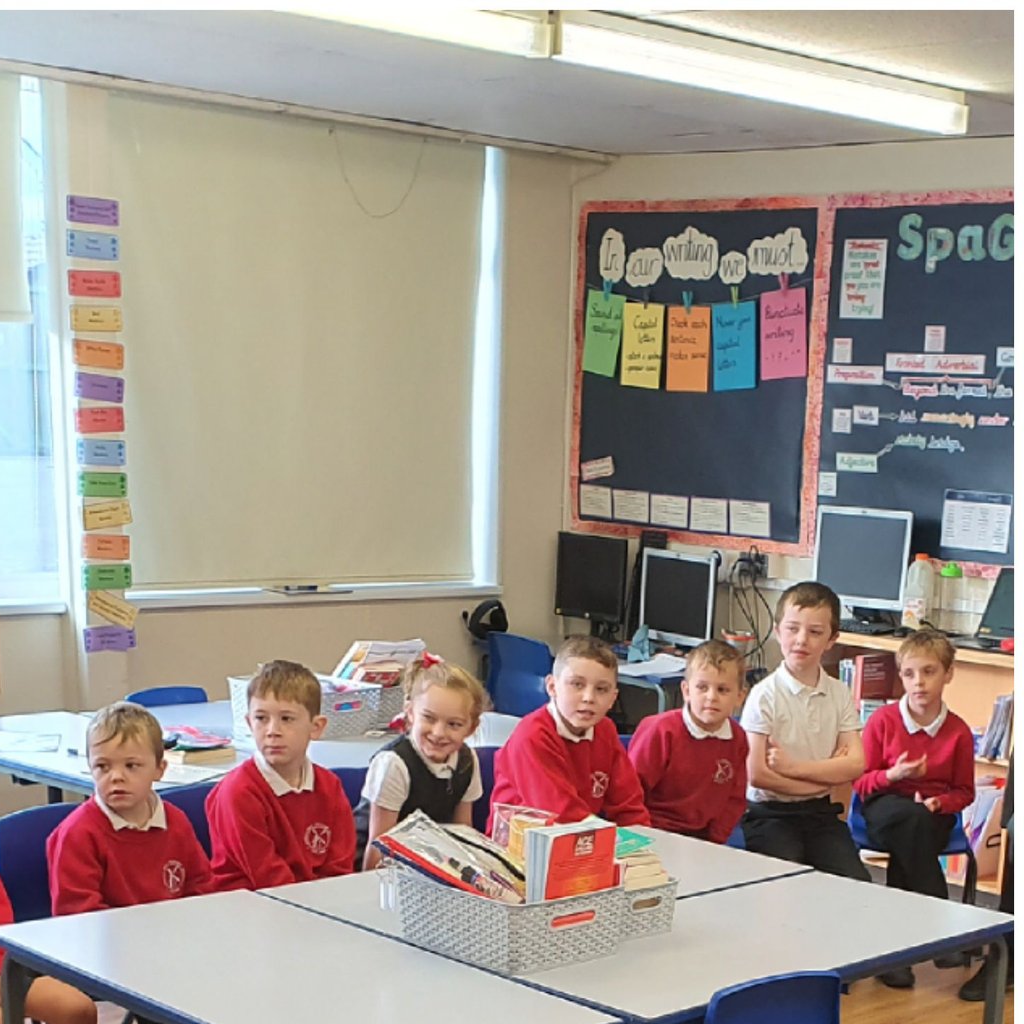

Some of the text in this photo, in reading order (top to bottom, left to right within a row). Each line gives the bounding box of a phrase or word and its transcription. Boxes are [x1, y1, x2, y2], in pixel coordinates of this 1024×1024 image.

[603, 238, 619, 271] In
[665, 231, 714, 272] writing
[897, 213, 1014, 273] SpaG
[630, 258, 658, 277] our
[723, 259, 743, 277] we
[765, 326, 795, 343] writing
